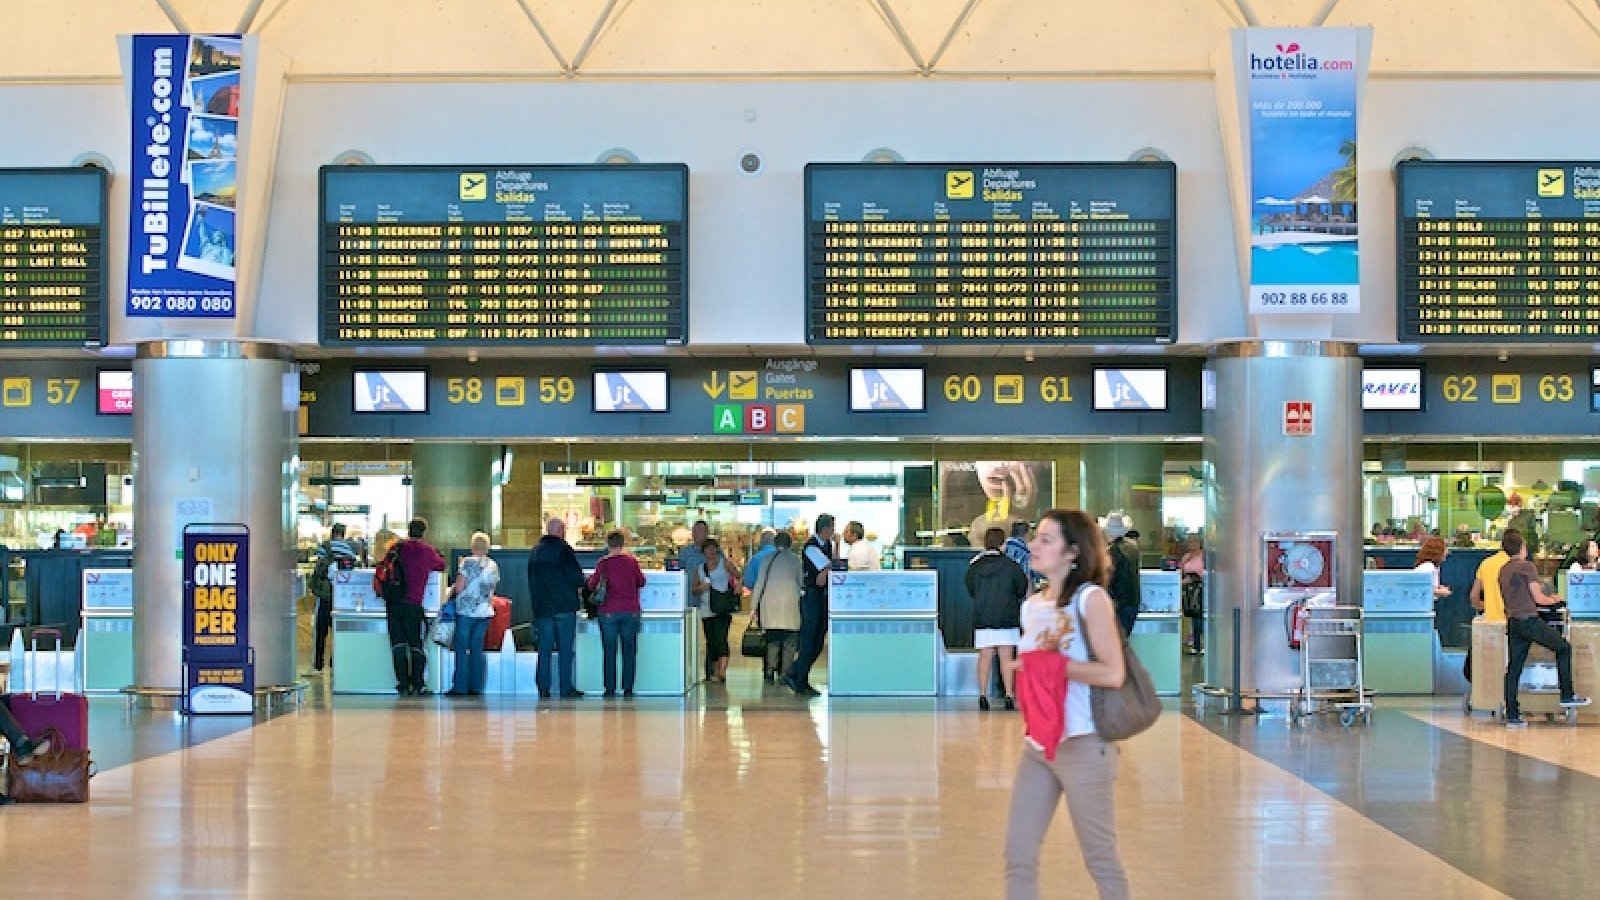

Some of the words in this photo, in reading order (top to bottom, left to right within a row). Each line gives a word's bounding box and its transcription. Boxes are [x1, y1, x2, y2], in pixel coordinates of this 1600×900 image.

[1251, 52, 1353, 70] hotelia.com
[30, 242, 54, 252] LAST
[62, 242, 86, 252] CALL
[30, 257, 54, 266] LAST
[62, 257, 86, 266] CALL
[131, 296, 161, 310] 902
[166, 296, 196, 311] 080
[202, 296, 232, 312] 080
[1261, 292, 1286, 305] 902
[1290, 292, 1307, 305] 88
[1311, 292, 1328, 305] 66
[1331, 292, 1348, 305] 88
[47, 378, 80, 404] 57
[448, 376, 483, 404] 58
[539, 376, 576, 404] 59
[766, 386, 815, 400] Puertas
[943, 375, 982, 402] 60
[1039, 376, 1072, 402] 61
[1442, 375, 1478, 402] 62
[1539, 375, 1574, 402] 63
[720, 408, 736, 429] A
[752, 408, 767, 429] B
[781, 408, 797, 429] C
[194, 542, 238, 561] ONLY
[194, 563, 237, 586] ONE
[194, 587, 237, 610] BAG
[194, 610, 237, 634] PER
